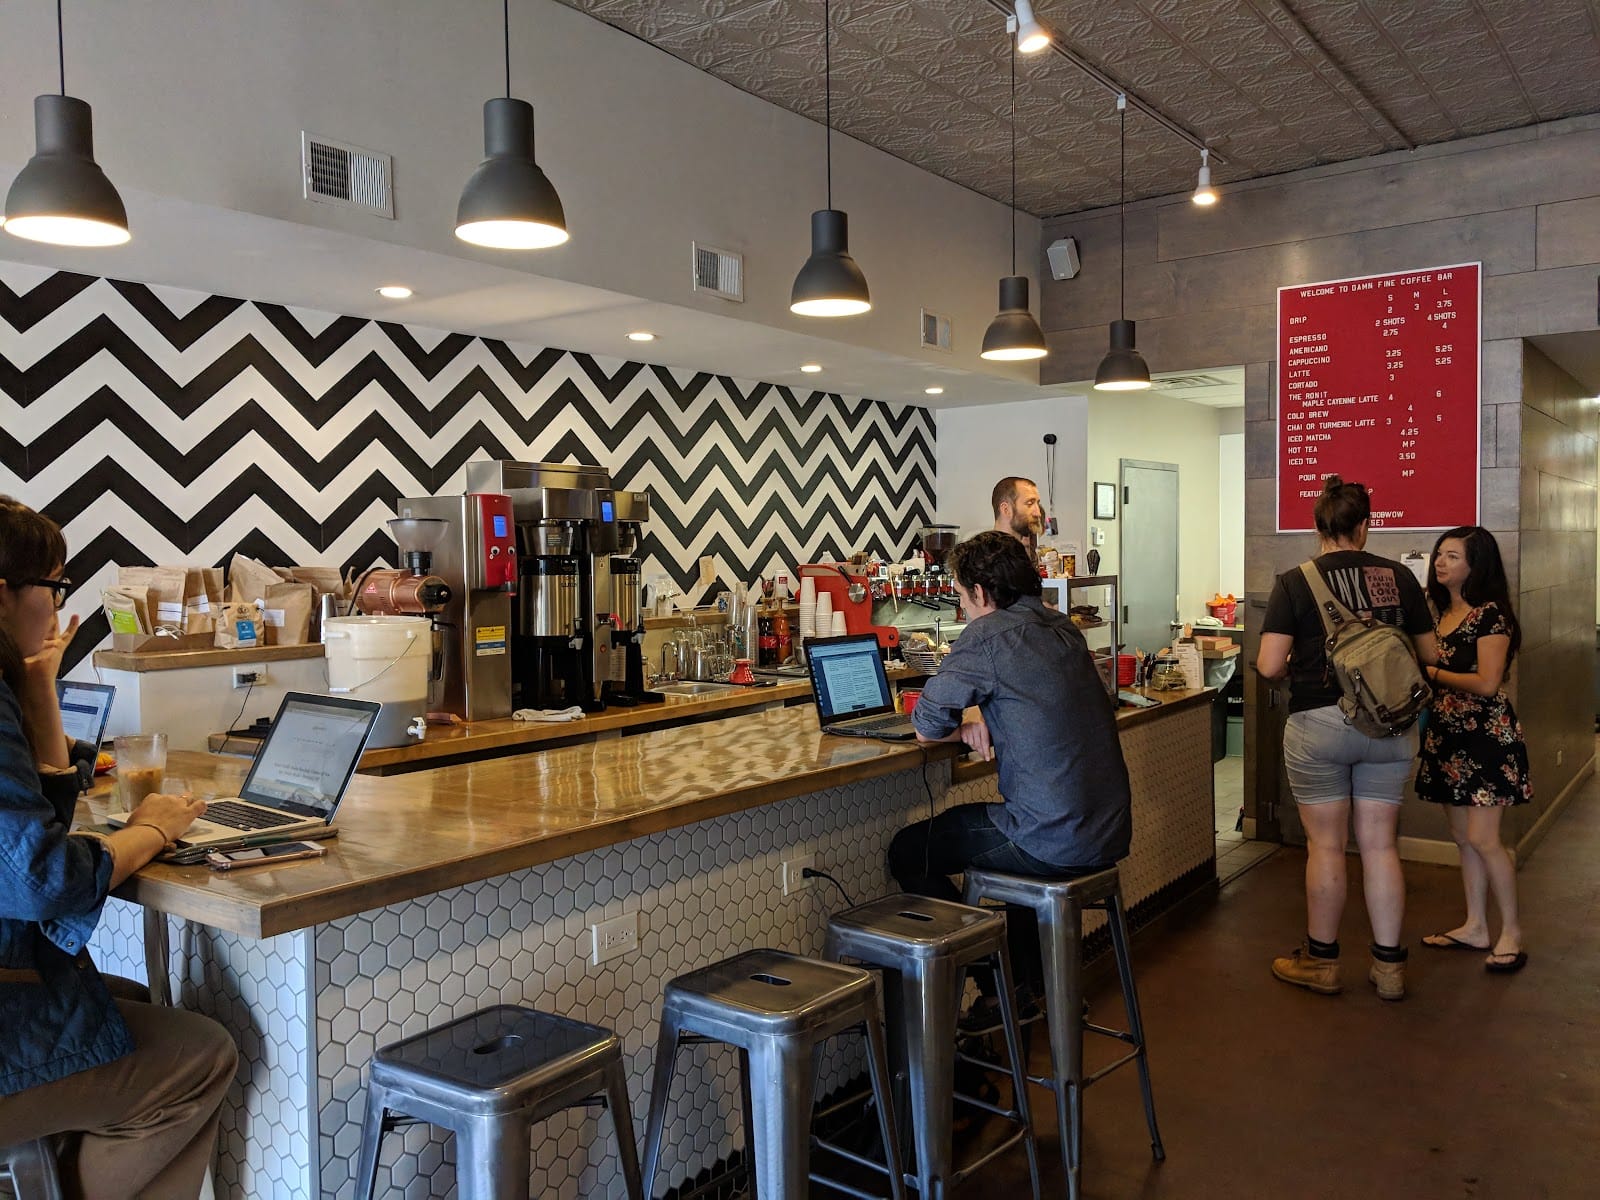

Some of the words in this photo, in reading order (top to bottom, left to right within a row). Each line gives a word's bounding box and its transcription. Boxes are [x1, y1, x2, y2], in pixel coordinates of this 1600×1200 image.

[1301, 287, 1334, 297] WELCOME
[1352, 282, 1373, 291] DAMN
[1378, 280, 1395, 288] FINE
[1401, 275, 1431, 285] COFFEE
[1438, 273, 1453, 281] BAR
[1437, 300, 1452, 308] 3.75
[1383, 318, 1405, 326] SHOTS
[1434, 312, 1456, 321] SHOTS
[1290, 334, 1327, 343] ESPRESSO
[1289, 345, 1328, 355] AMERICANO
[1288, 357, 1330, 366] CAPPUCCINO
[1289, 370, 1311, 378] LATTE
[1387, 361, 1403, 369] 3.25
[1436, 357, 1451, 365] 5.25
[1289, 381, 1318, 389] CORTADO
[1303, 399, 1325, 407] MAPLE
[1328, 397, 1355, 406] CAYENNE
[1359, 395, 1379, 403] LATTE
[1288, 412, 1304, 420] COLD
[1309, 410, 1329, 418] BREW
[1319, 420, 1351, 429] TURMERIC
[1355, 419, 1375, 427] LATTE
[1306, 434, 1331, 442] MATCHA
[1401, 428, 1419, 436] 4.25
[1399, 452, 1416, 460] 3.50
